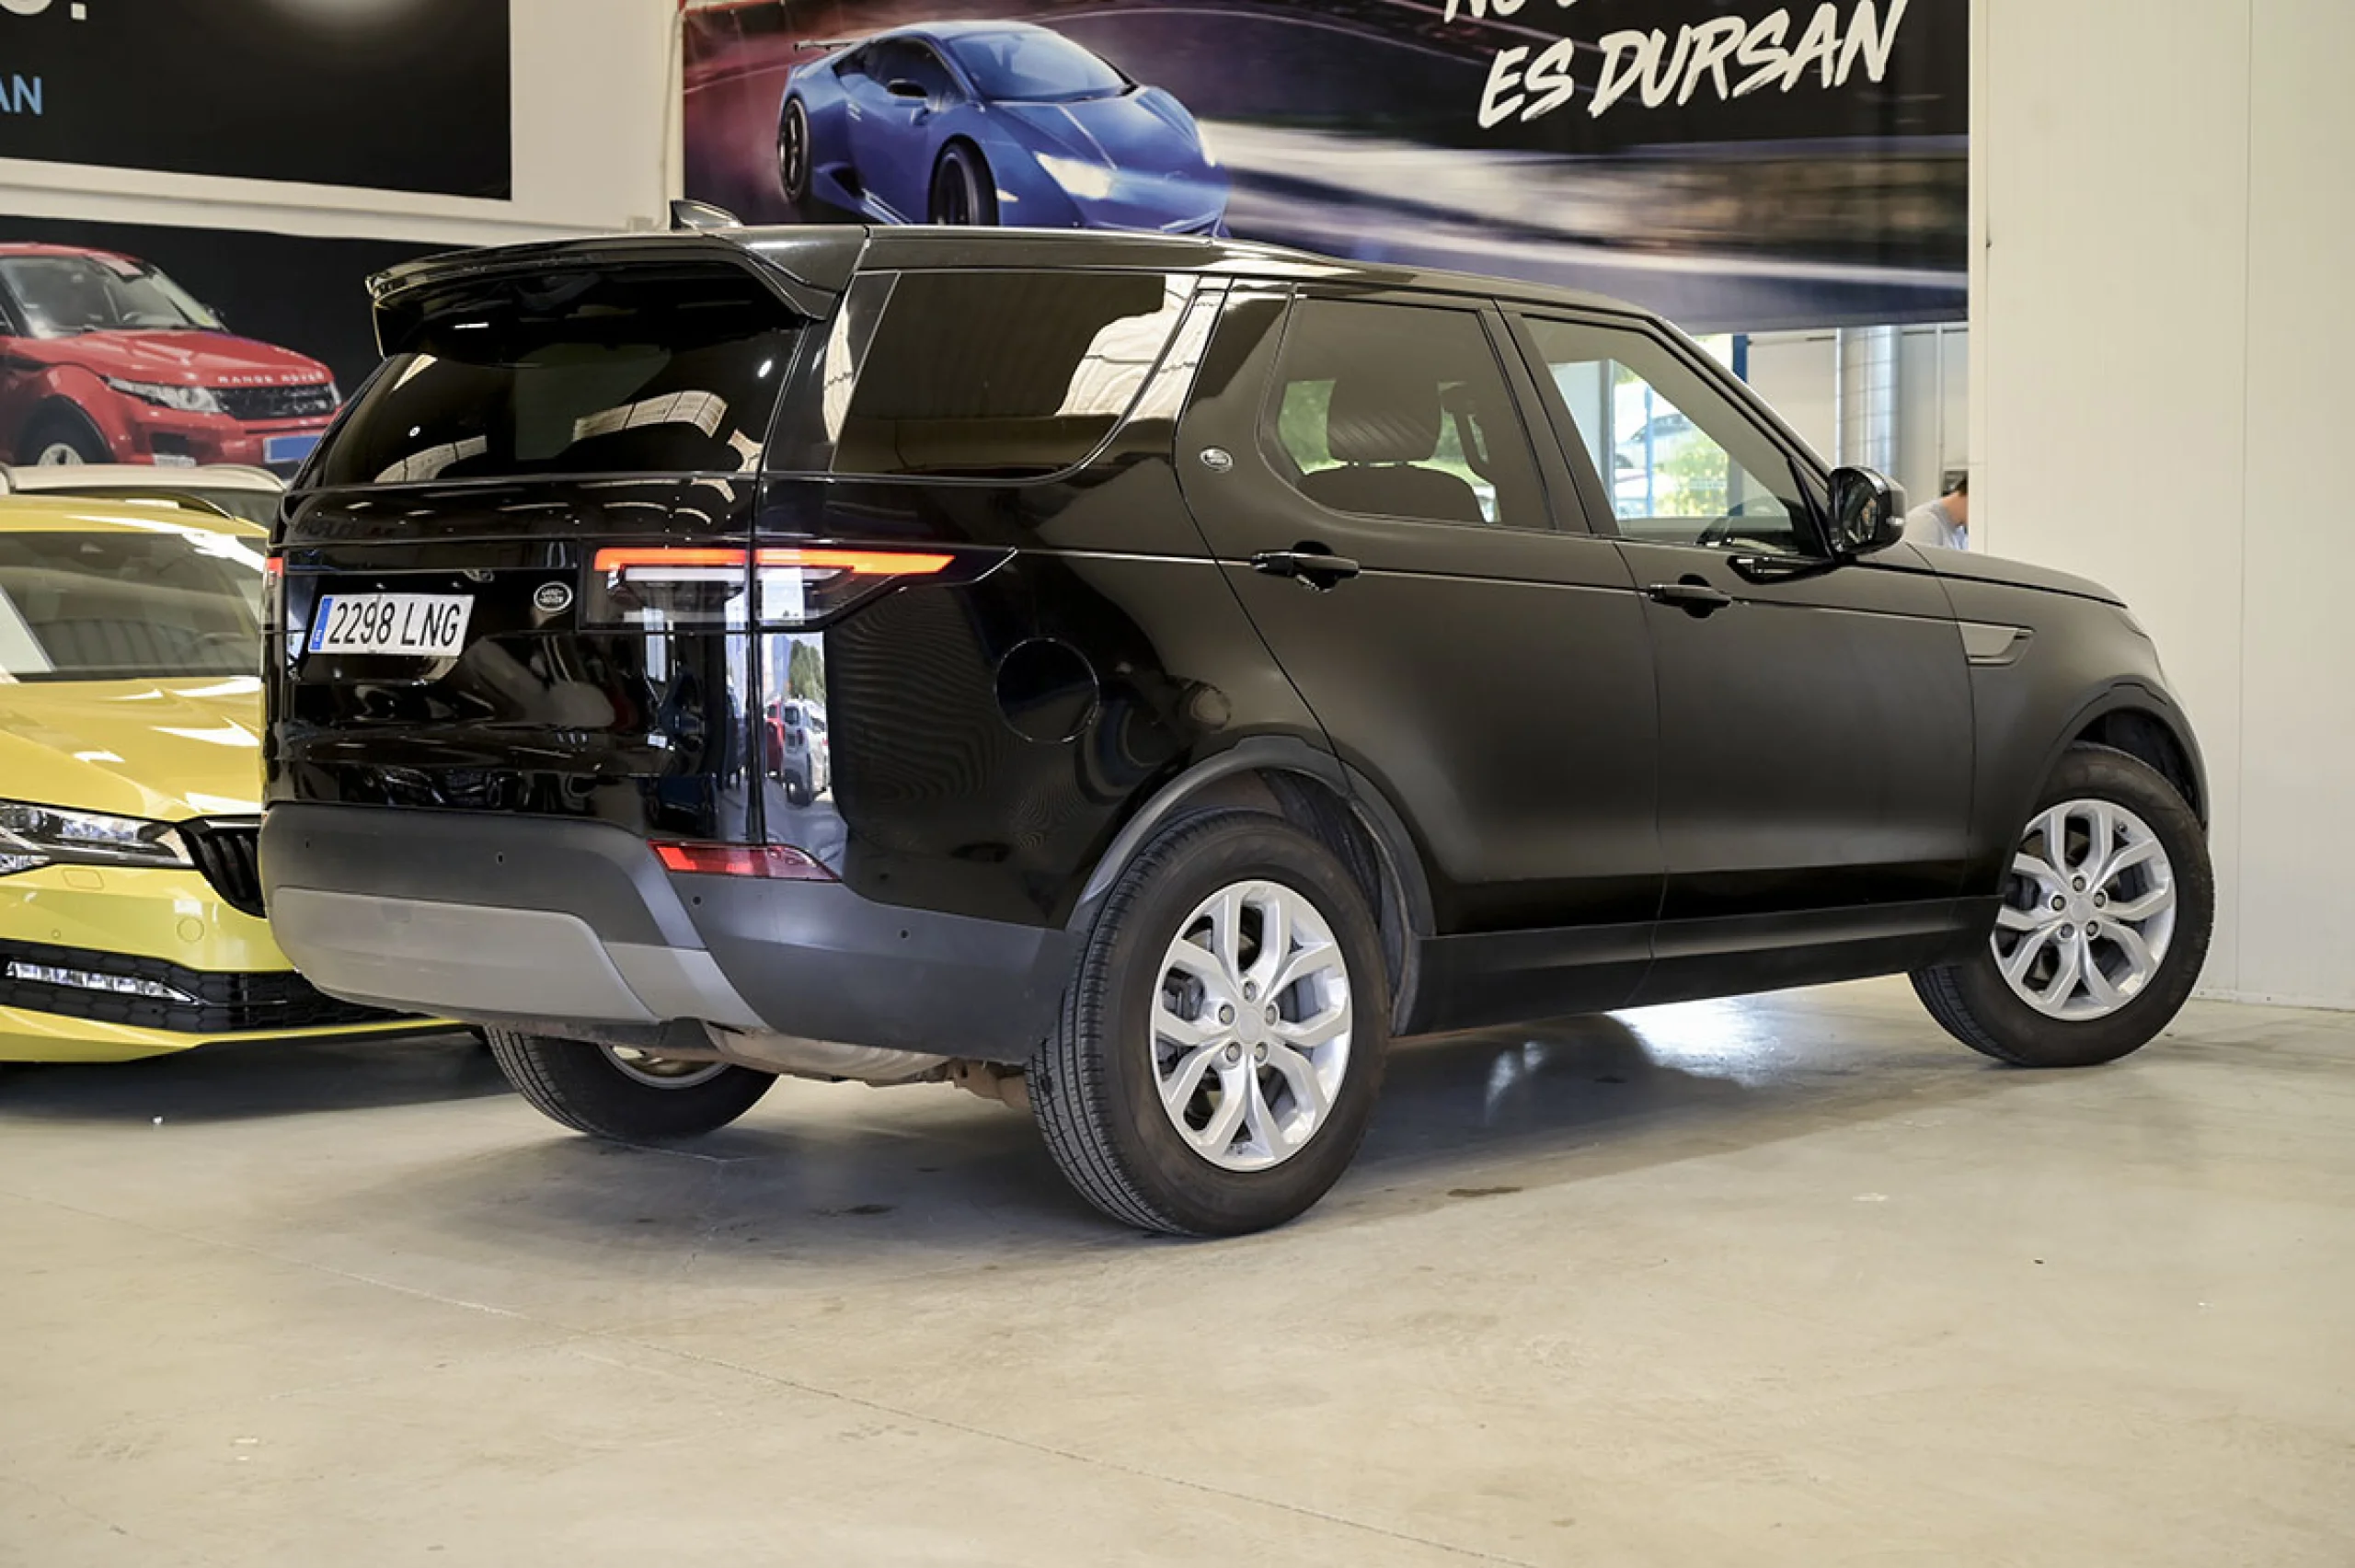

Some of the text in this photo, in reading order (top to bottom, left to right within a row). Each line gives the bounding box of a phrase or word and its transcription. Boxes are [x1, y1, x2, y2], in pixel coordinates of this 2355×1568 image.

[1477, 0, 1910, 129] ES DURSAN
[328, 601, 462, 647] 2298 LNG
